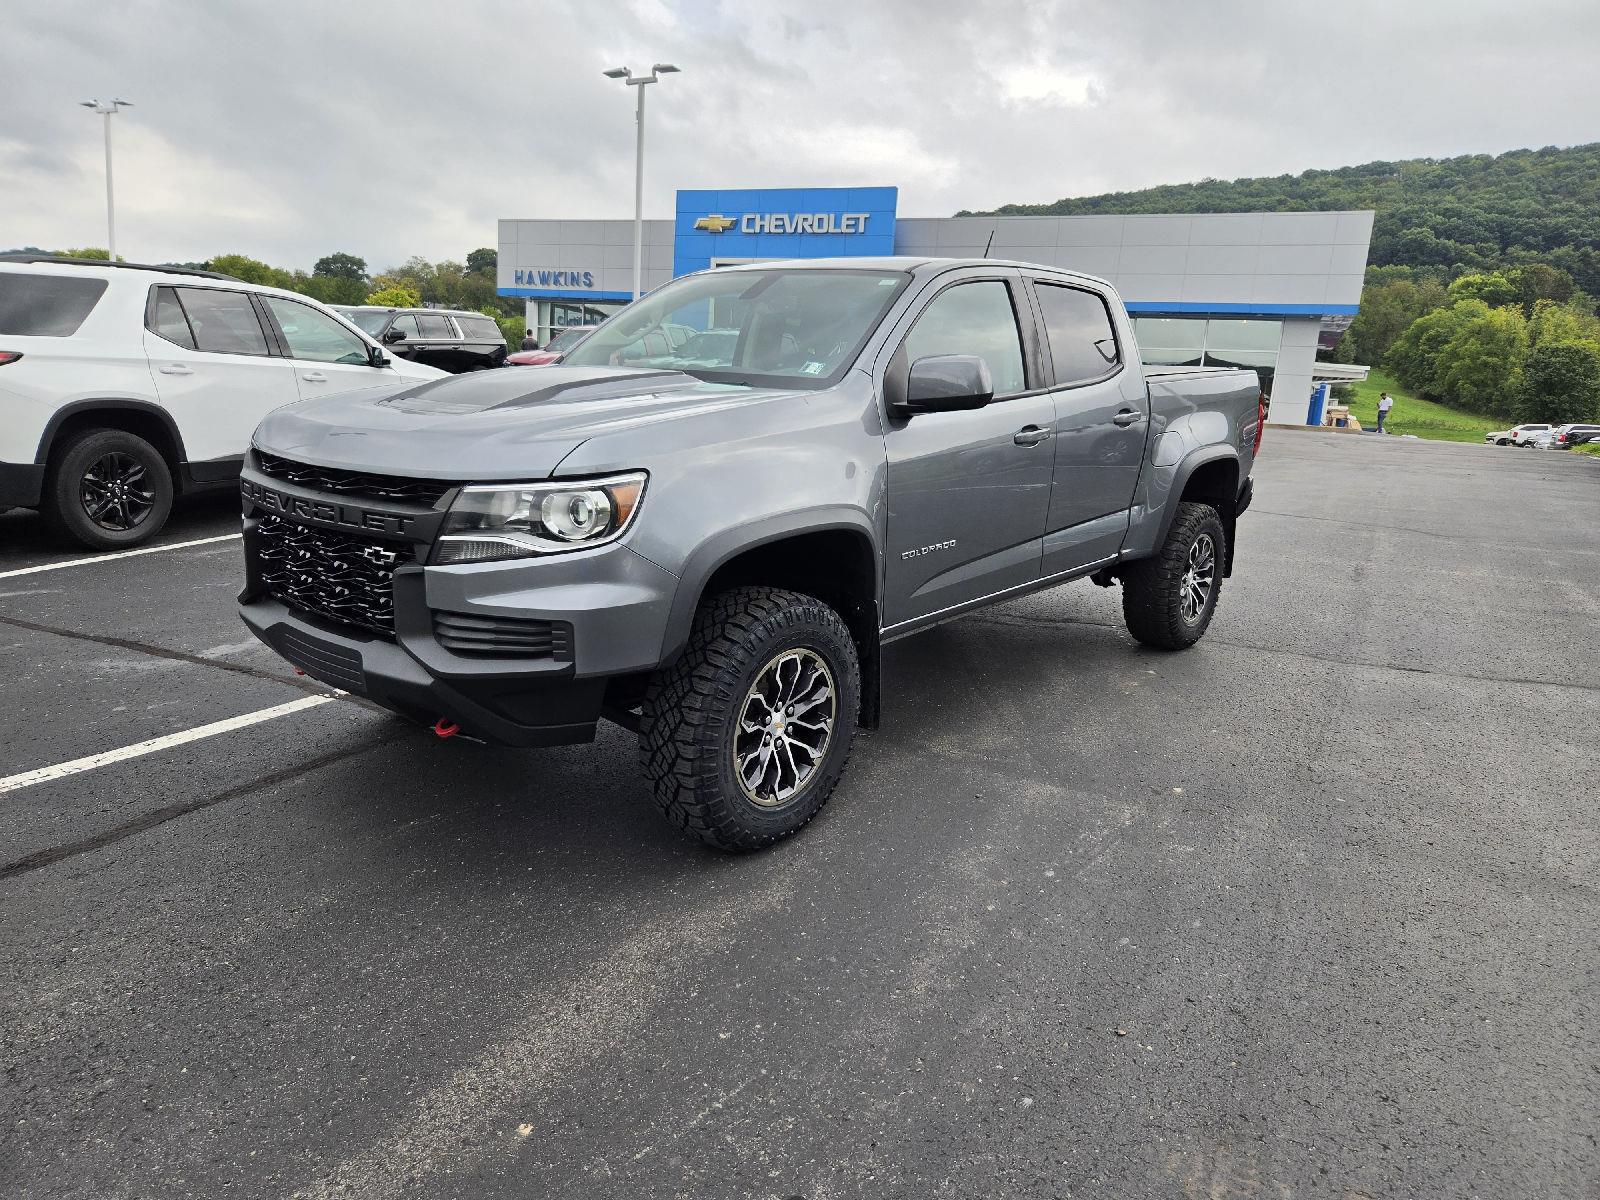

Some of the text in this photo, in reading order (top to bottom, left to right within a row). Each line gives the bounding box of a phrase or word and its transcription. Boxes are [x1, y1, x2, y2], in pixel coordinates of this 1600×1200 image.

[741, 213, 870, 234] CHEVROLET
[514, 269, 594, 288] HAWKINS
[241, 481, 415, 535] CHEVROLET
[901, 539, 957, 560] COLORADO
